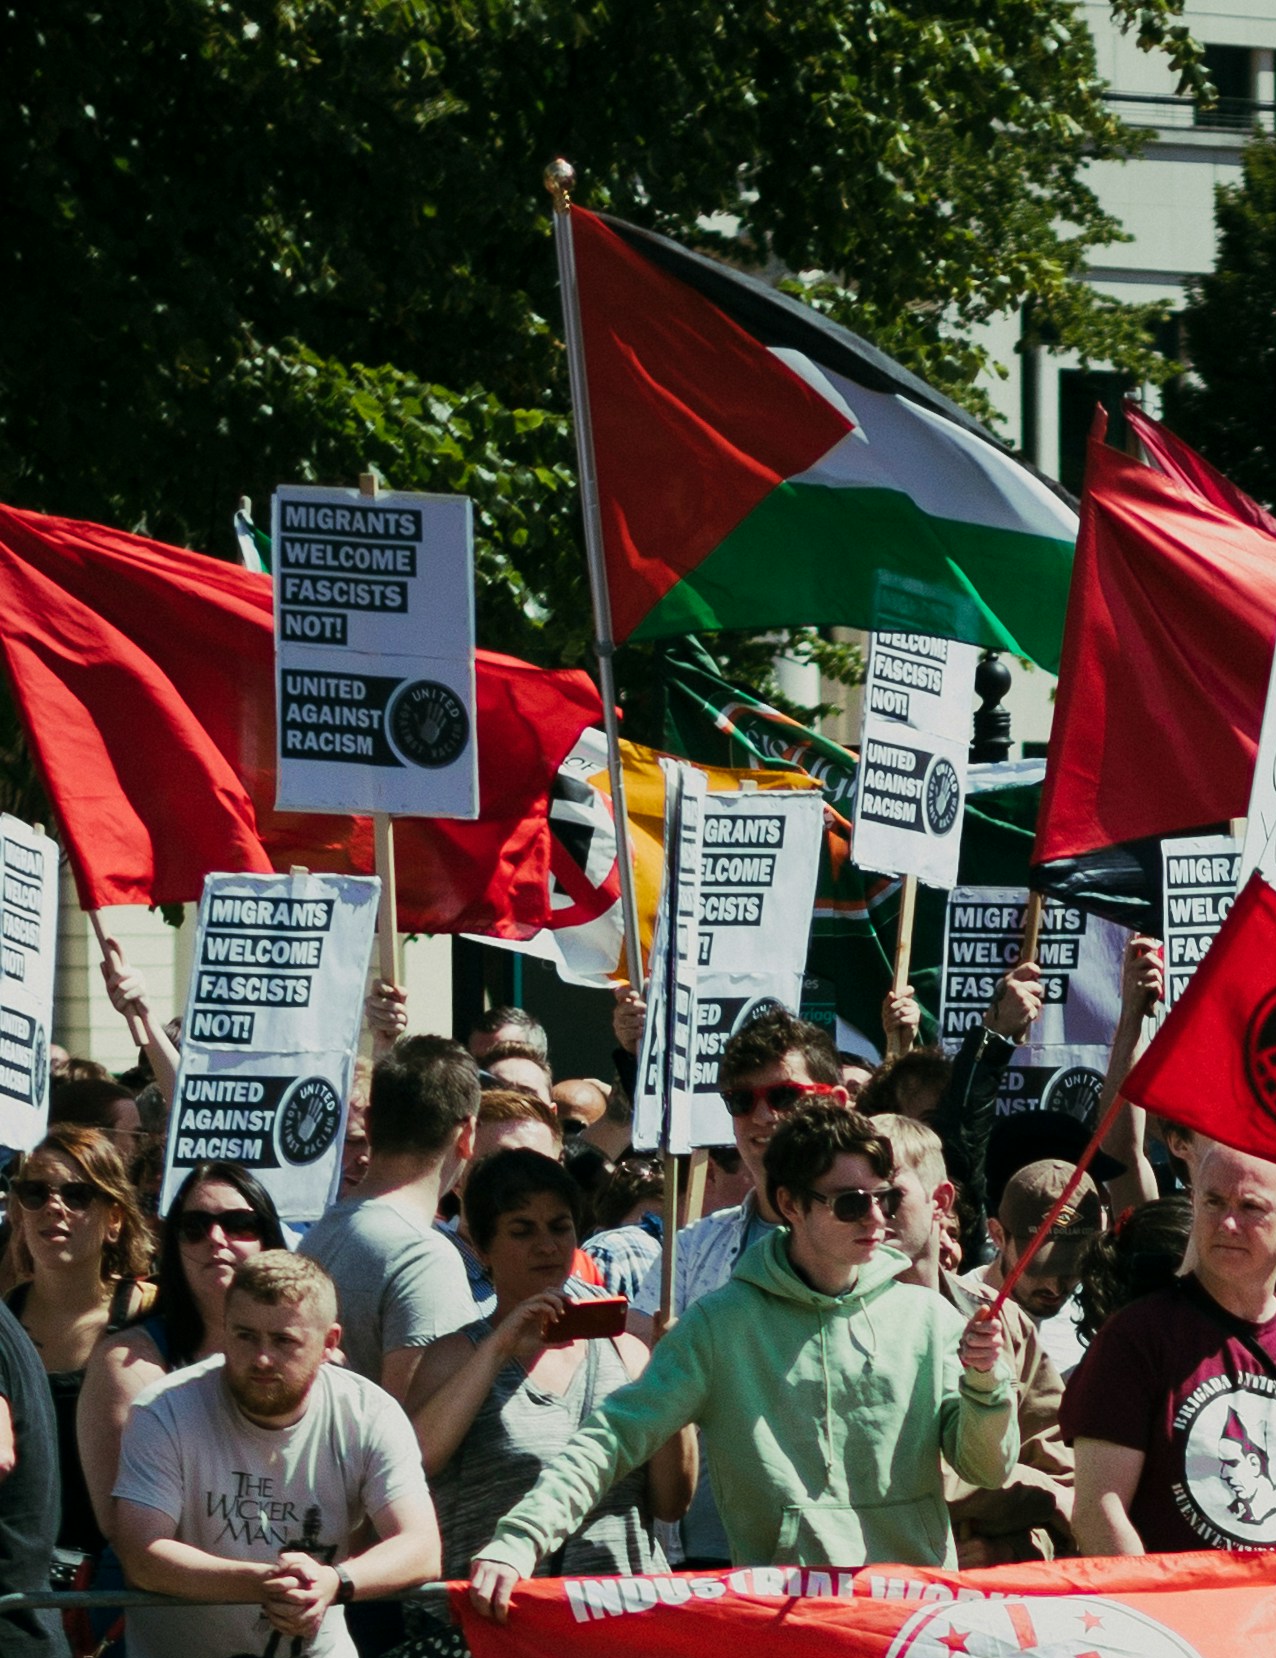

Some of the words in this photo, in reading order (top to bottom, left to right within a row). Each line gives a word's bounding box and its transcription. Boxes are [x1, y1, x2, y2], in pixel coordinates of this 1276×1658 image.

[284, 505, 416, 537] MIGRANTS
[284, 541, 412, 572] WELCOME
[284, 577, 403, 608] FASCISTS
[284, 614, 343, 639] NOT!
[877, 632, 948, 661] WELCOME
[875, 653, 942, 693] FASCISTS
[286, 675, 367, 701] UNITED
[872, 686, 908, 716] NOT!
[286, 703, 383, 730] AGAINST
[286, 729, 374, 757] RACISM
[867, 742, 916, 772] UNITED
[865, 769, 924, 800] AGAINST
[862, 793, 917, 824] RACISM
[210, 898, 329, 928] MIGRANTS
[206, 938, 320, 965] WELCOME
[199, 975, 310, 1004] FASCISTS
[193, 1014, 250, 1038] NOT!
[185, 1079, 264, 1102] UNITED
[300, 1082, 336, 1112] UNITED
[181, 1109, 275, 1132] AGAINST
[177, 1137, 262, 1160] RACISM
[1172, 1374, 1233, 1431] BRIGADA
[231, 1471, 275, 1499] THE
[206, 1491, 299, 1522] WICKER
[213, 1518, 288, 1546] MAN
[564, 1566, 855, 1624] INDUSTRIAL
